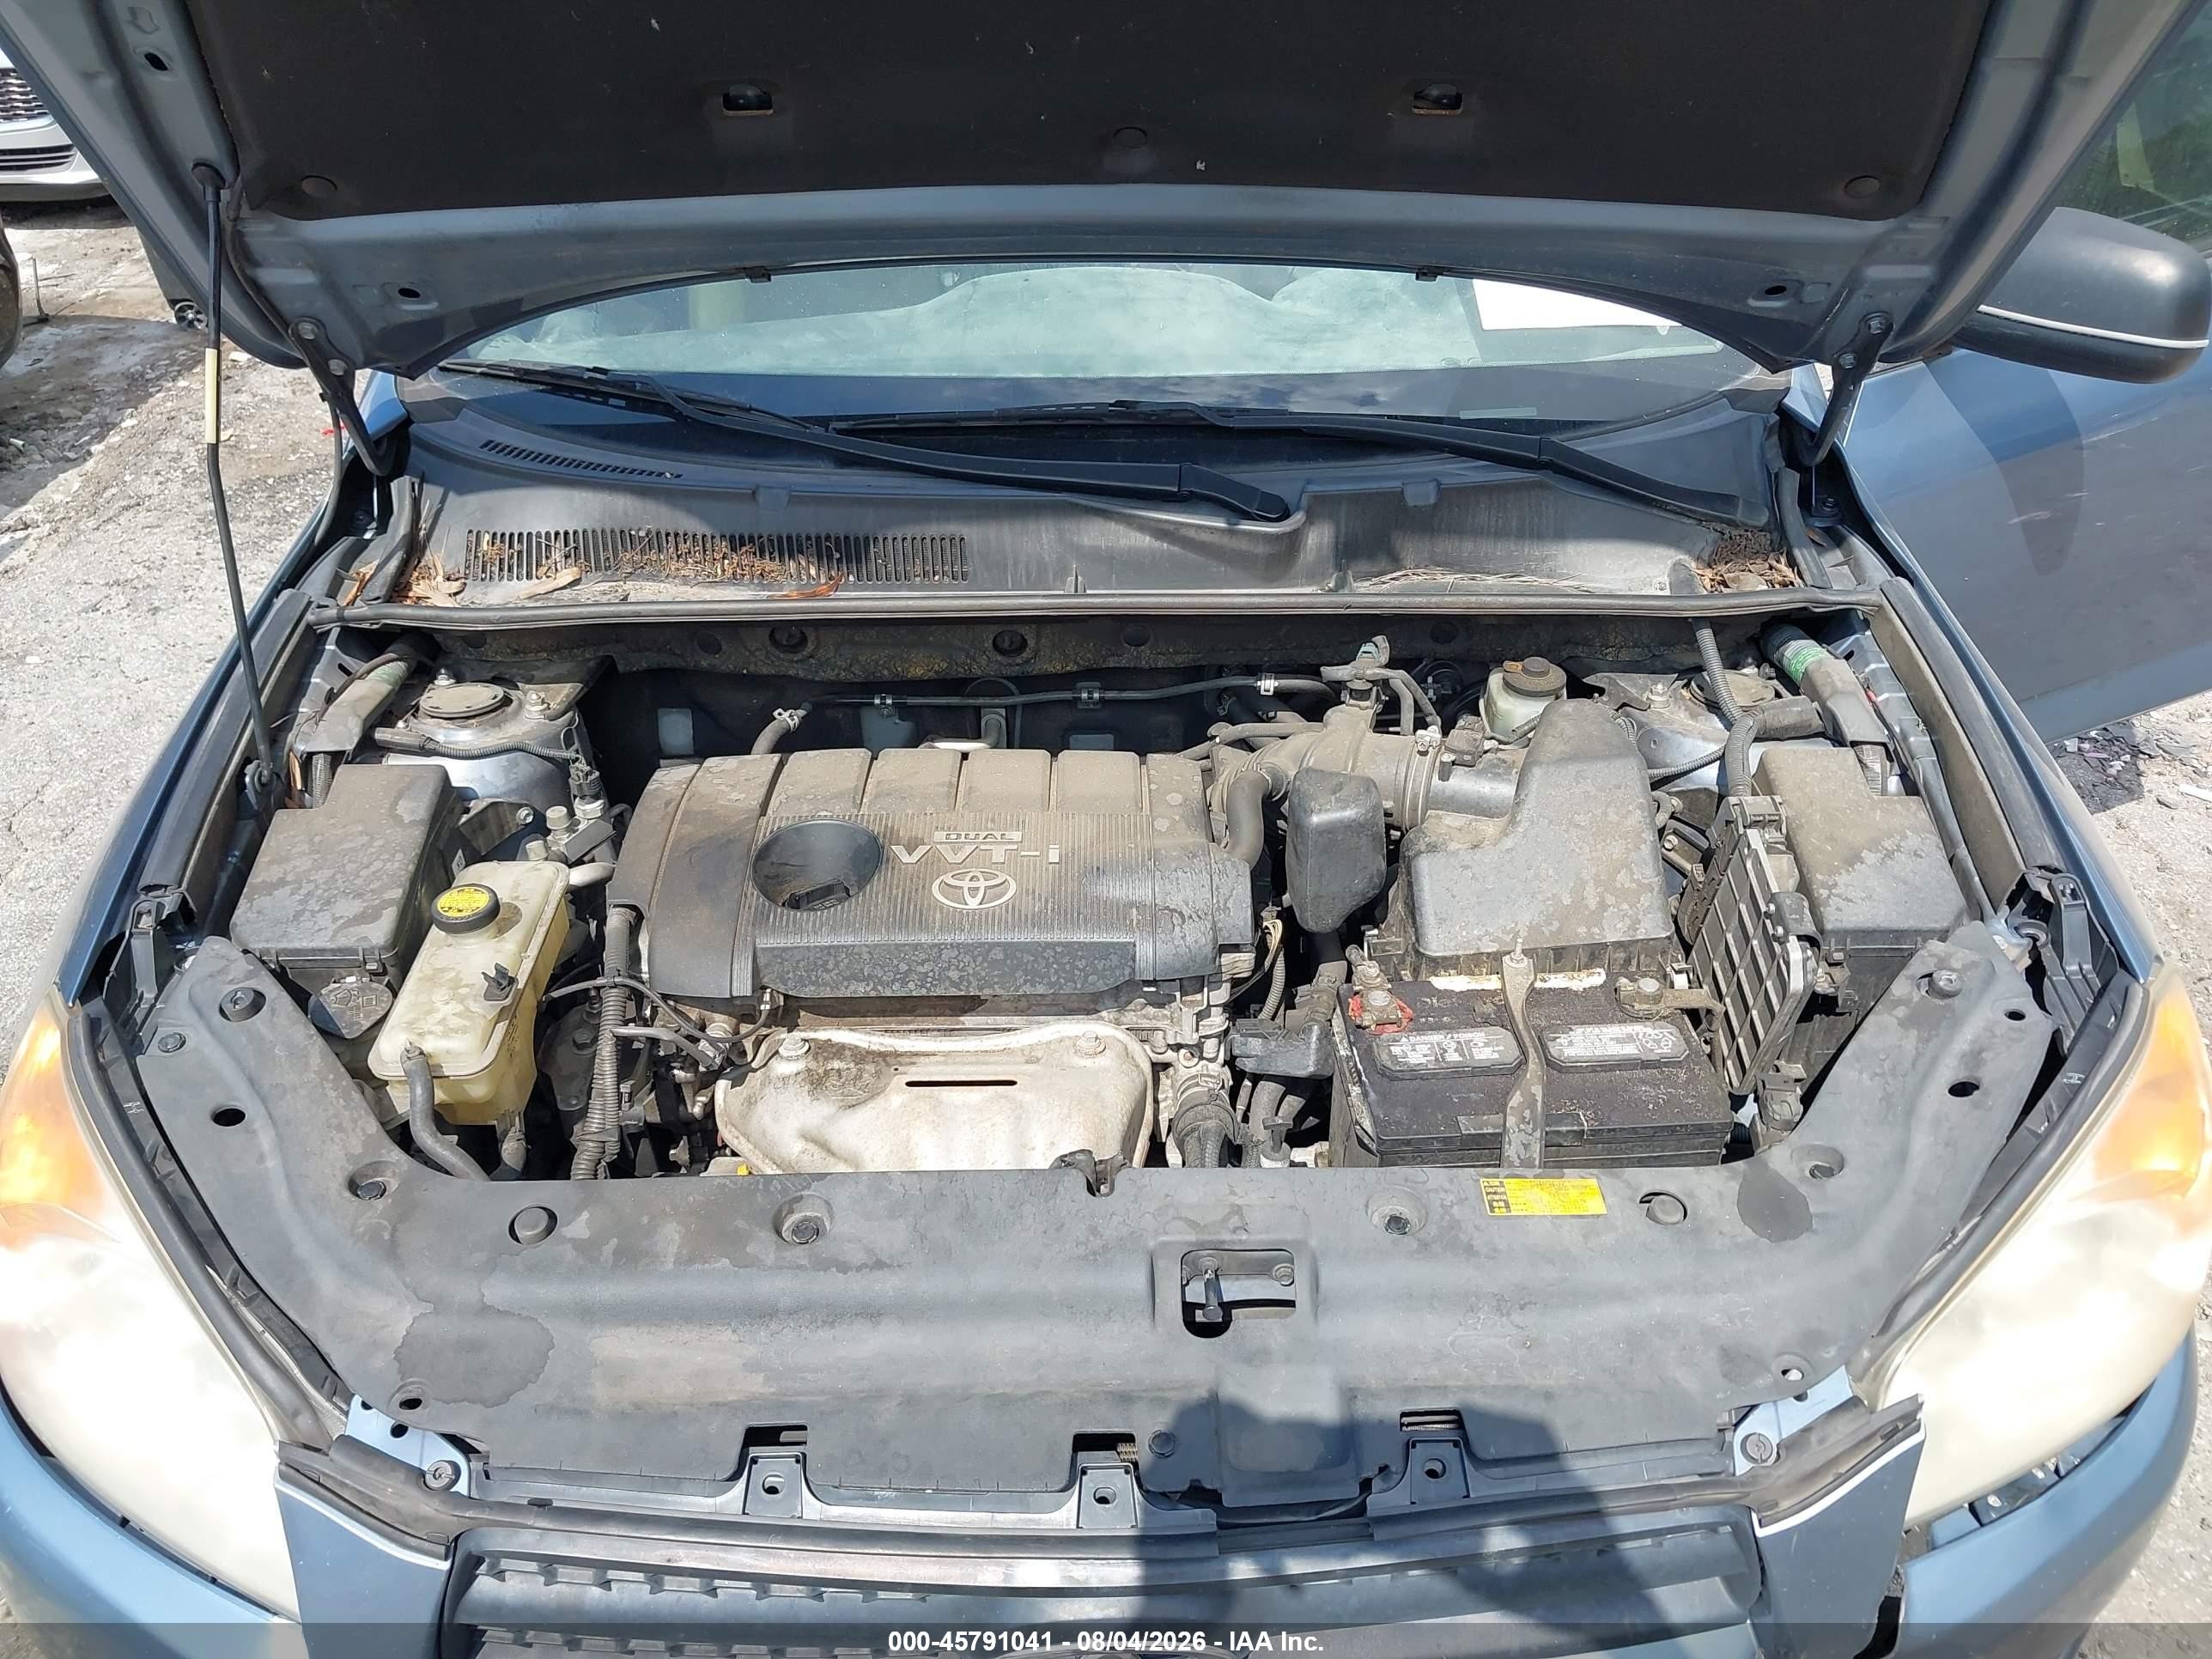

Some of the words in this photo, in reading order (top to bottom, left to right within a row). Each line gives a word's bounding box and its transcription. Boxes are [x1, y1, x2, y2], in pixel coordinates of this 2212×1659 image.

[945, 832, 1015, 842] DUAL
[890, 844, 1060, 865] VVT-i
[1408, 1034, 1445, 1042] DANGER
